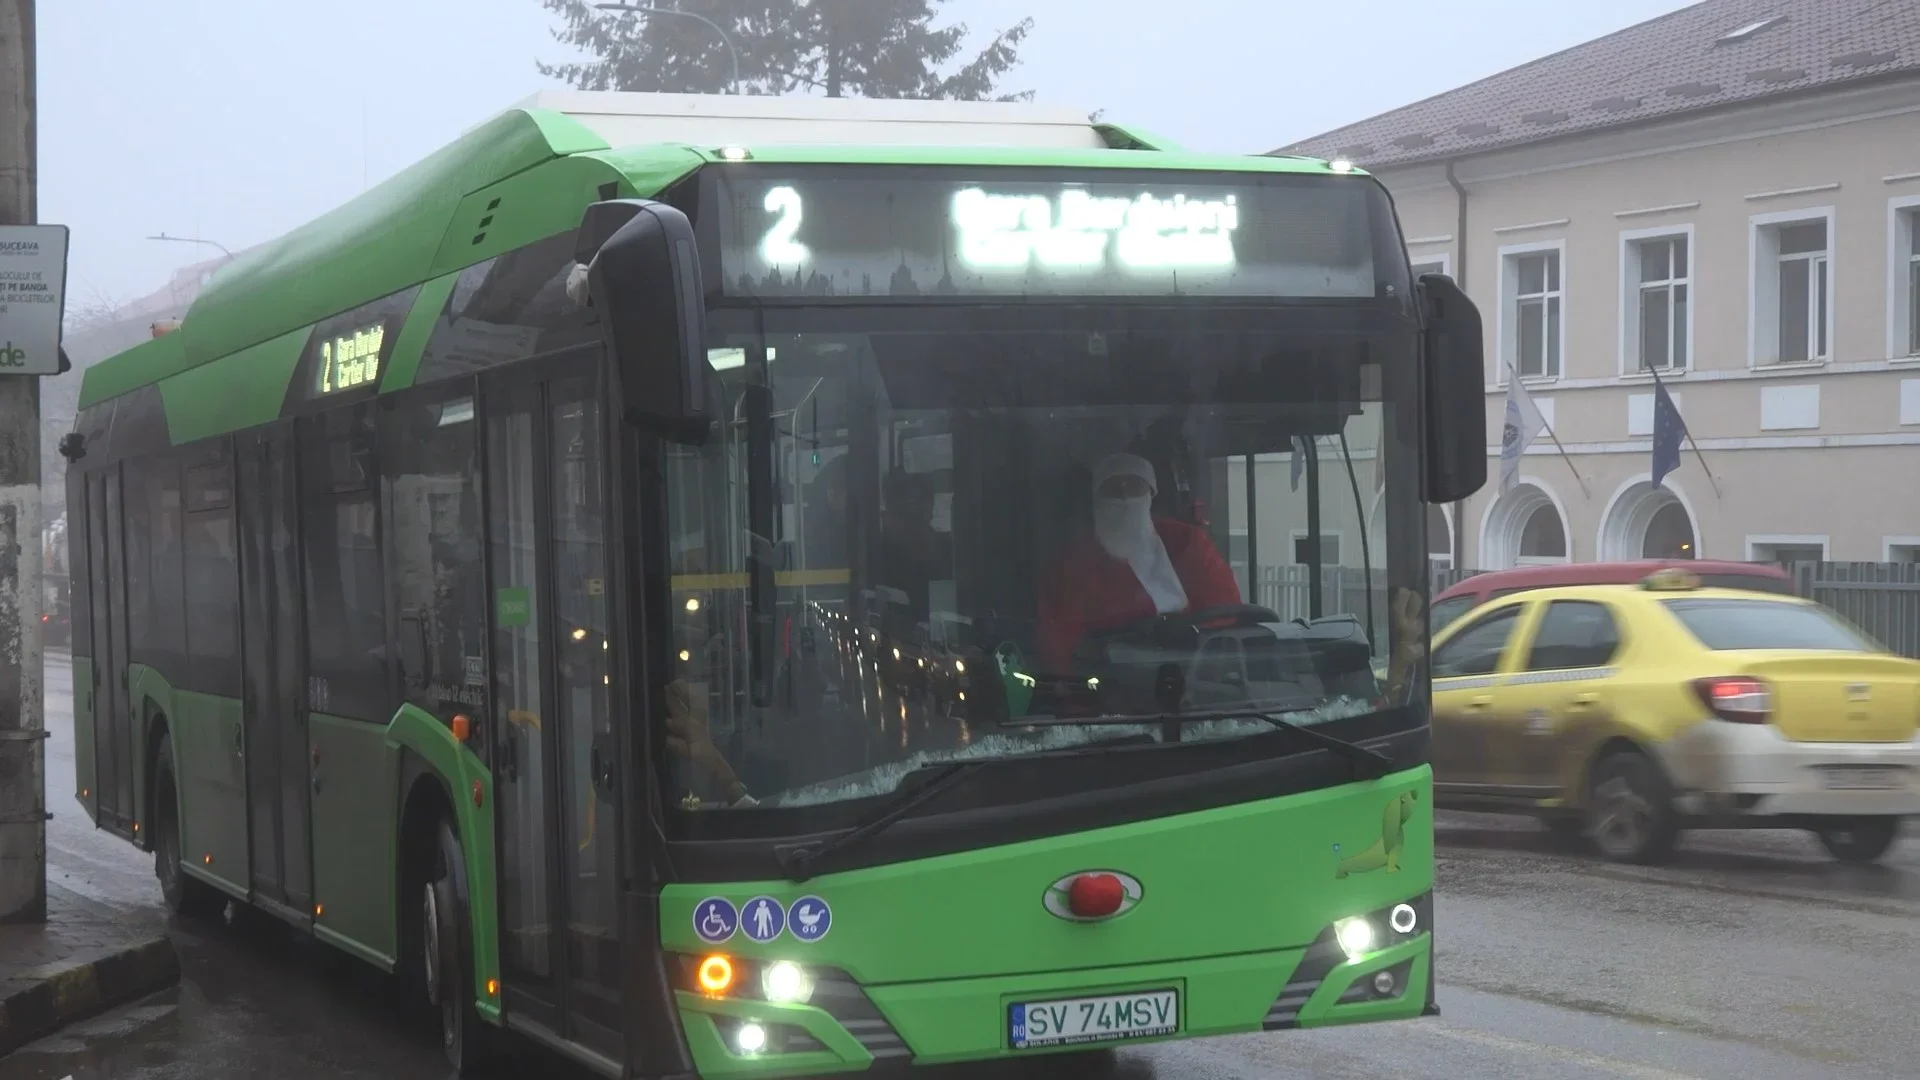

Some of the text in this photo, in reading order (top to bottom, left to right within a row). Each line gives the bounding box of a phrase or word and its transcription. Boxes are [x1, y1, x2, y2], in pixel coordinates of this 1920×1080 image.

[764, 187, 809, 264] 2
[0, 241, 39, 250] SUCEAVA
[8, 283, 17, 291] PE
[19, 284, 48, 292] BANDA
[32, 272, 43, 281] DE
[323, 342, 331, 392] 2
[1012, 1024, 1025, 1038] RO
[1029, 1005, 1068, 1036] SV
[1080, 996, 1171, 1032] 74MSV
